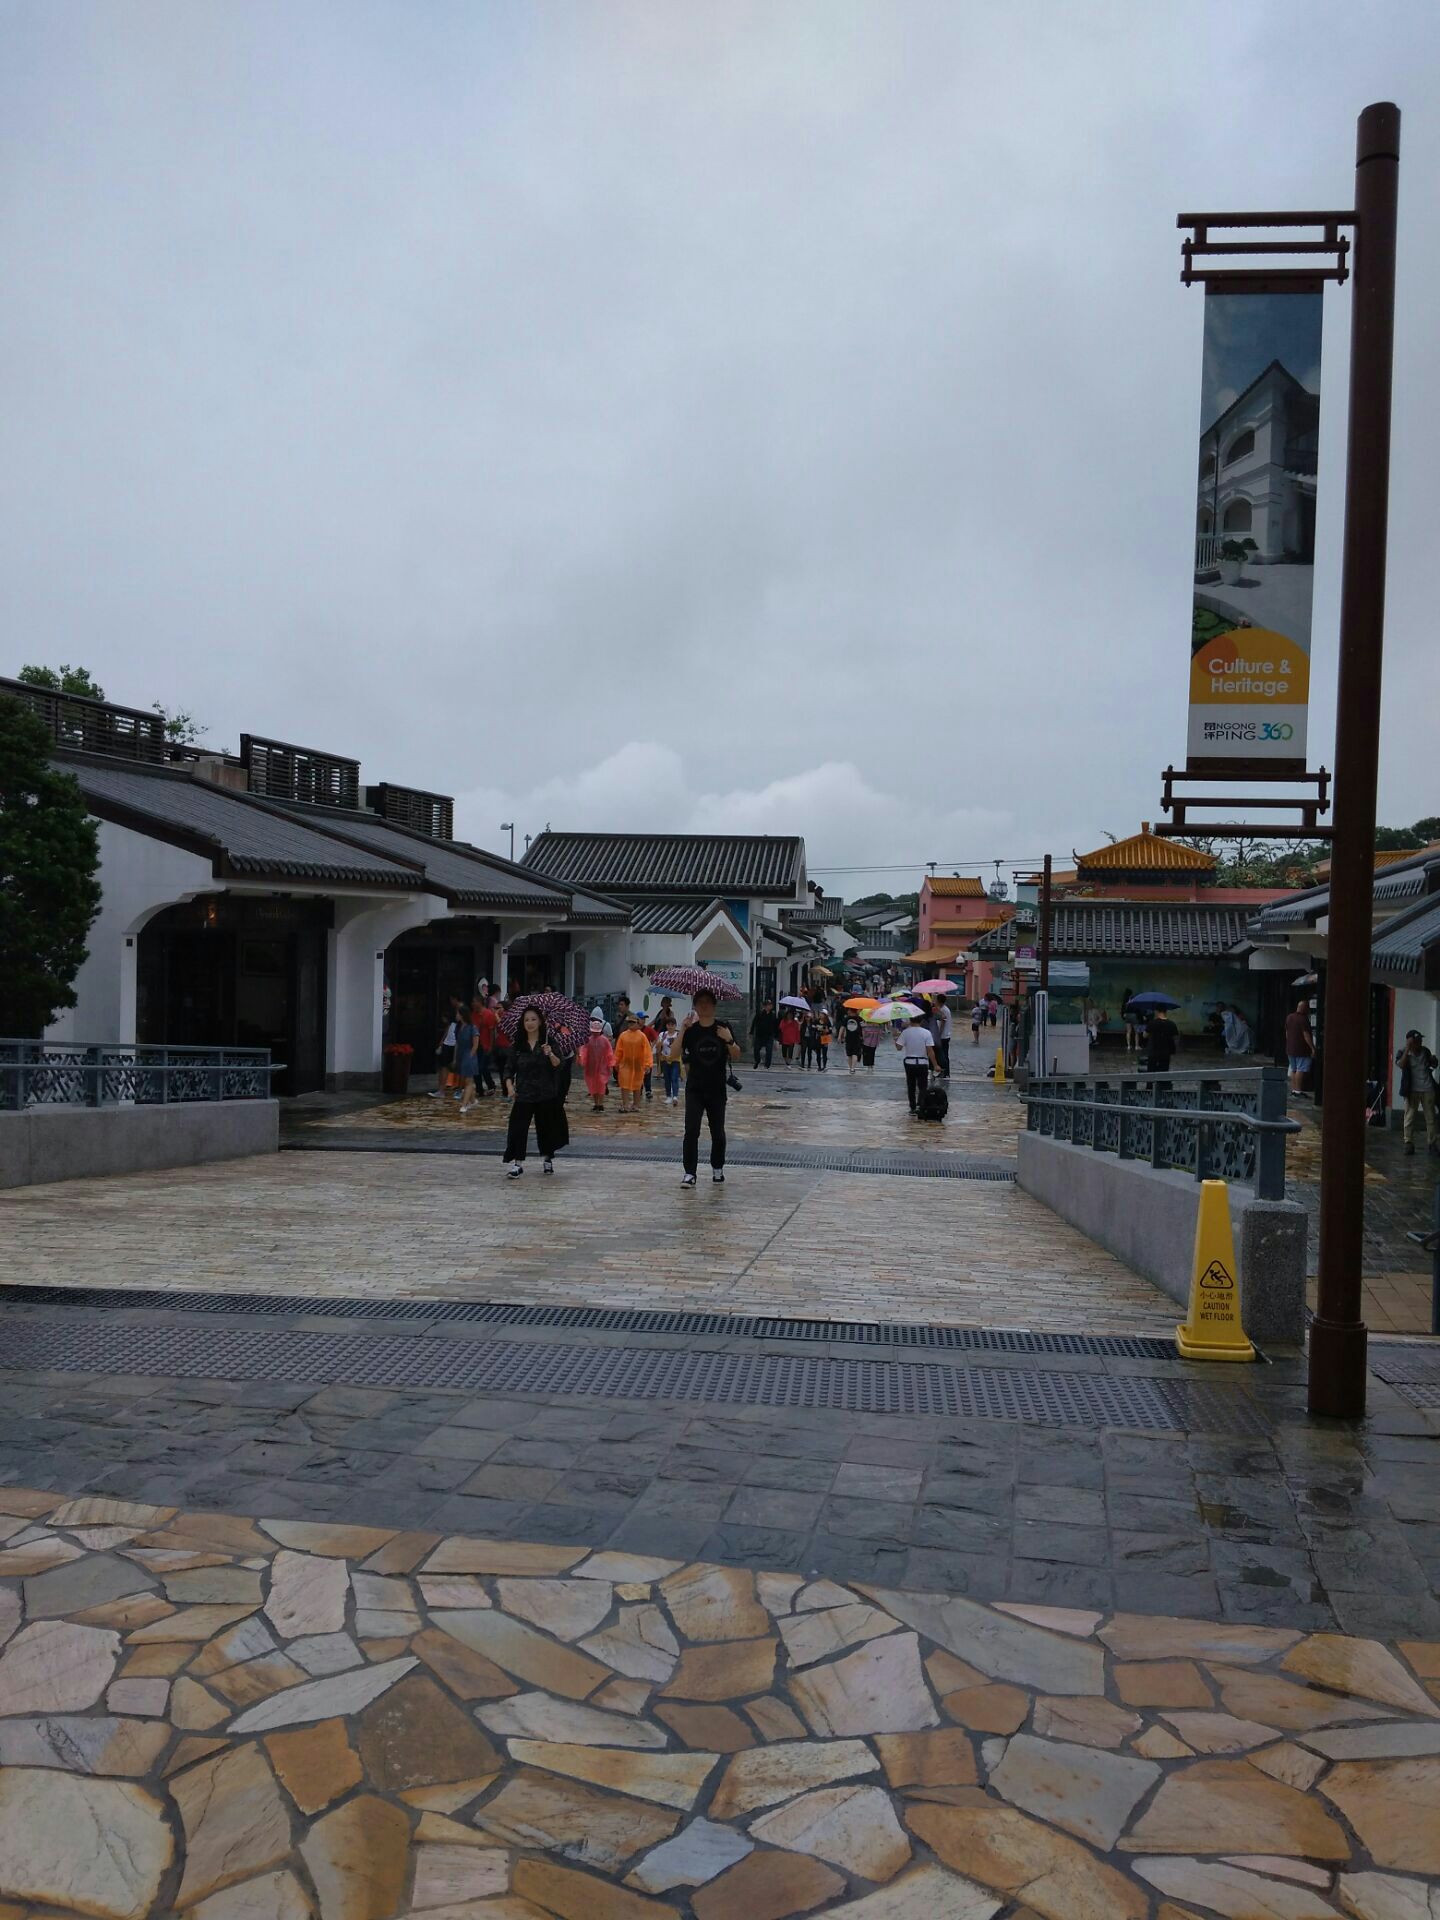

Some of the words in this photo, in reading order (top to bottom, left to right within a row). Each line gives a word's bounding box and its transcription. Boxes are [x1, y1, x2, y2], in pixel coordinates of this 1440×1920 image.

[1209, 658, 1274, 674] Culture
[1279, 659, 1292, 674] &
[1211, 678, 1289, 696] Heritage
[1216, 731, 1256, 740] PING
[1217, 722, 1256, 730] NGONG
[1257, 722, 1293, 740] 360
[1203, 1302, 1230, 1311] CAUTION
[1200, 1312, 1213, 1320] WET
[1214, 1312, 1234, 1321] FLOOR
